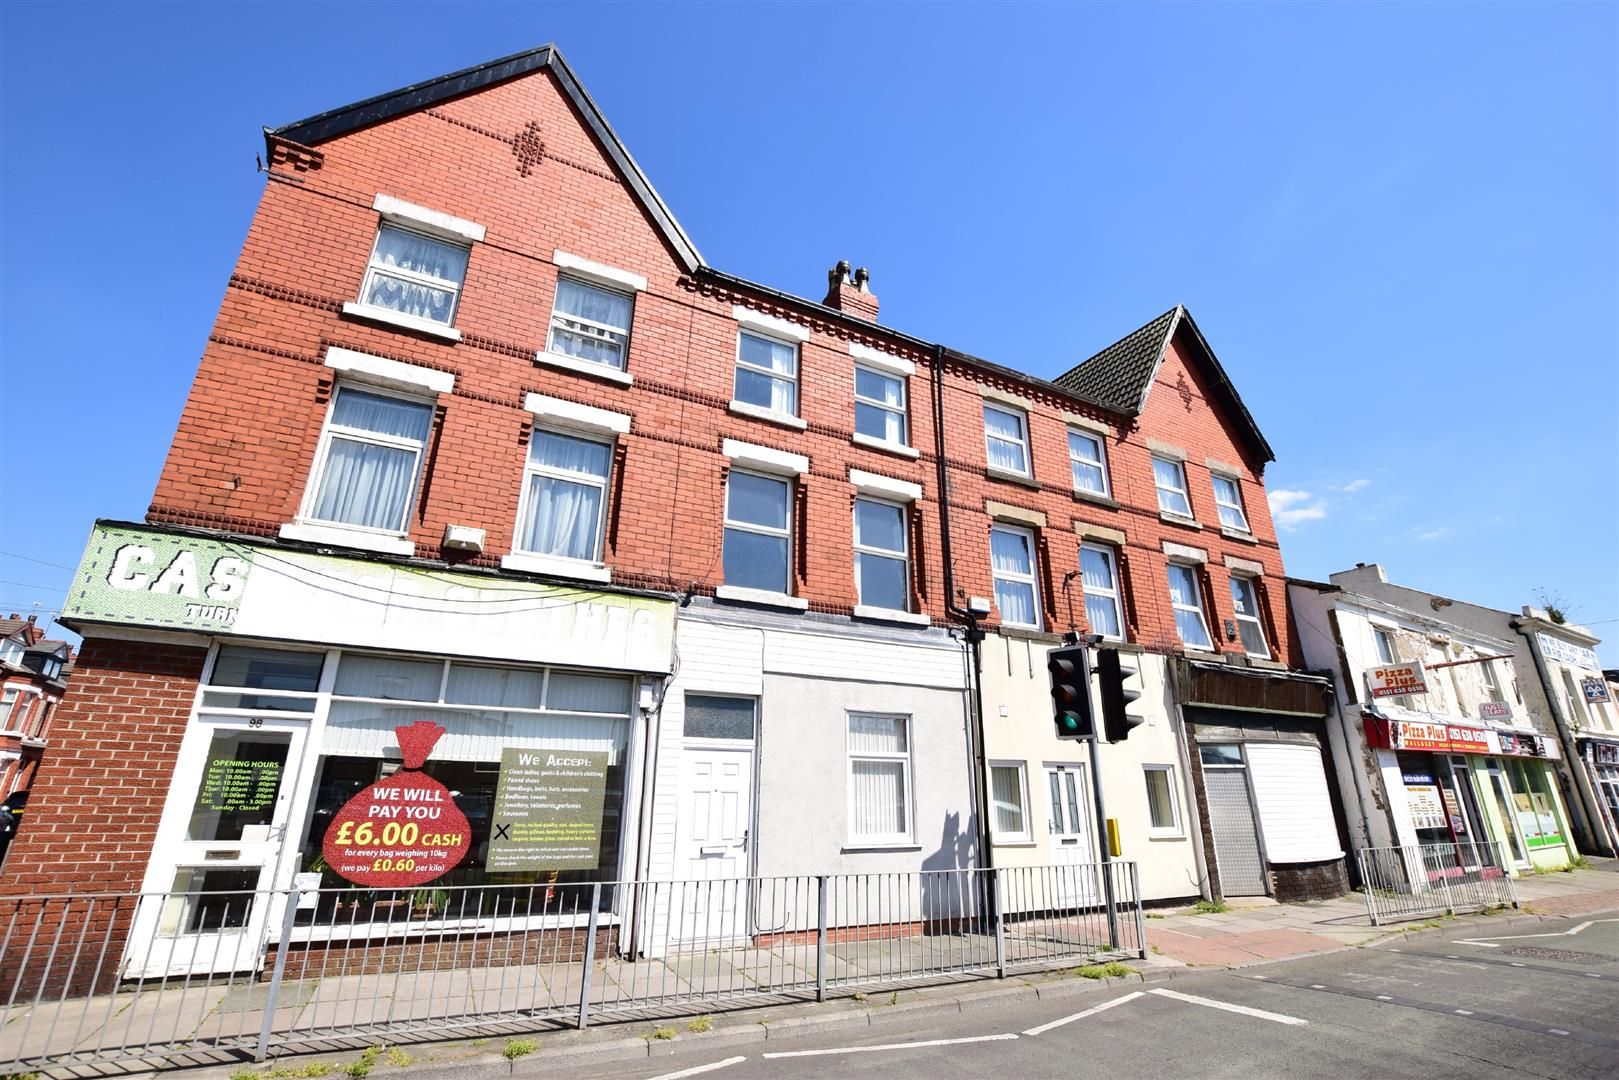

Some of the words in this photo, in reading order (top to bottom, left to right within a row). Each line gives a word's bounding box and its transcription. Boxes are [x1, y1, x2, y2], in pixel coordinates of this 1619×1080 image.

[1375, 668, 1413, 679] Pizza
[1385, 676, 1416, 687] Plus
[249, 718, 264, 728] 98
[1402, 722, 1425, 738] Pizza
[1426, 725, 1445, 739] Plus
[213, 759, 250, 768] OPENING
[250, 761, 280, 769] HOURS
[519, 753, 540, 766] We
[373, 787, 400, 801] WE
[403, 788, 444, 802] WILL
[211, 804, 235, 812] Sunday
[368, 805, 402, 818] PAY
[405, 806, 441, 820] YOU
[335, 821, 419, 846] £6.00
[421, 833, 462, 847] CASH
[344, 849, 358, 857] for
[357, 850, 379, 858] every
[379, 849, 394, 859] bag
[395, 849, 429, 859] weighing
[430, 849, 448, 859] 10kg
[341, 864, 356, 873] (we
[356, 865, 371, 874] pay
[373, 858, 415, 872] £0.60
[415, 865, 428, 873] per
[428, 863, 445, 873] kilo)
